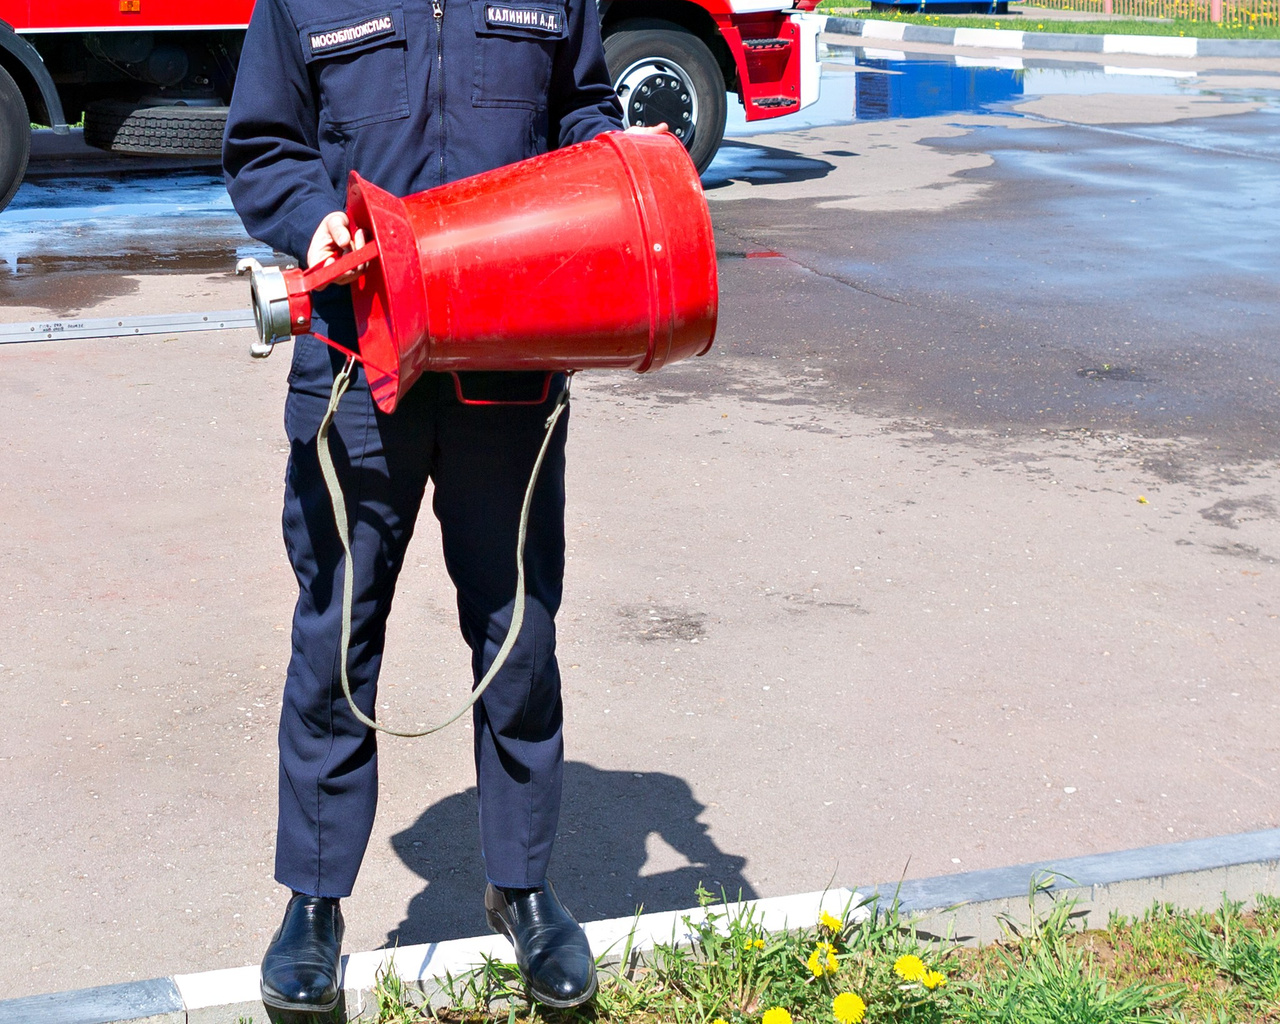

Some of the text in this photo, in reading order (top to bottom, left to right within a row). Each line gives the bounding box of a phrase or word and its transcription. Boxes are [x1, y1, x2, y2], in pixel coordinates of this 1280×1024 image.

[311, 17, 392, 49] МОСОБЛПОЖСПАС
[487, 7, 558, 31] КАЛИНИН А.Д.
